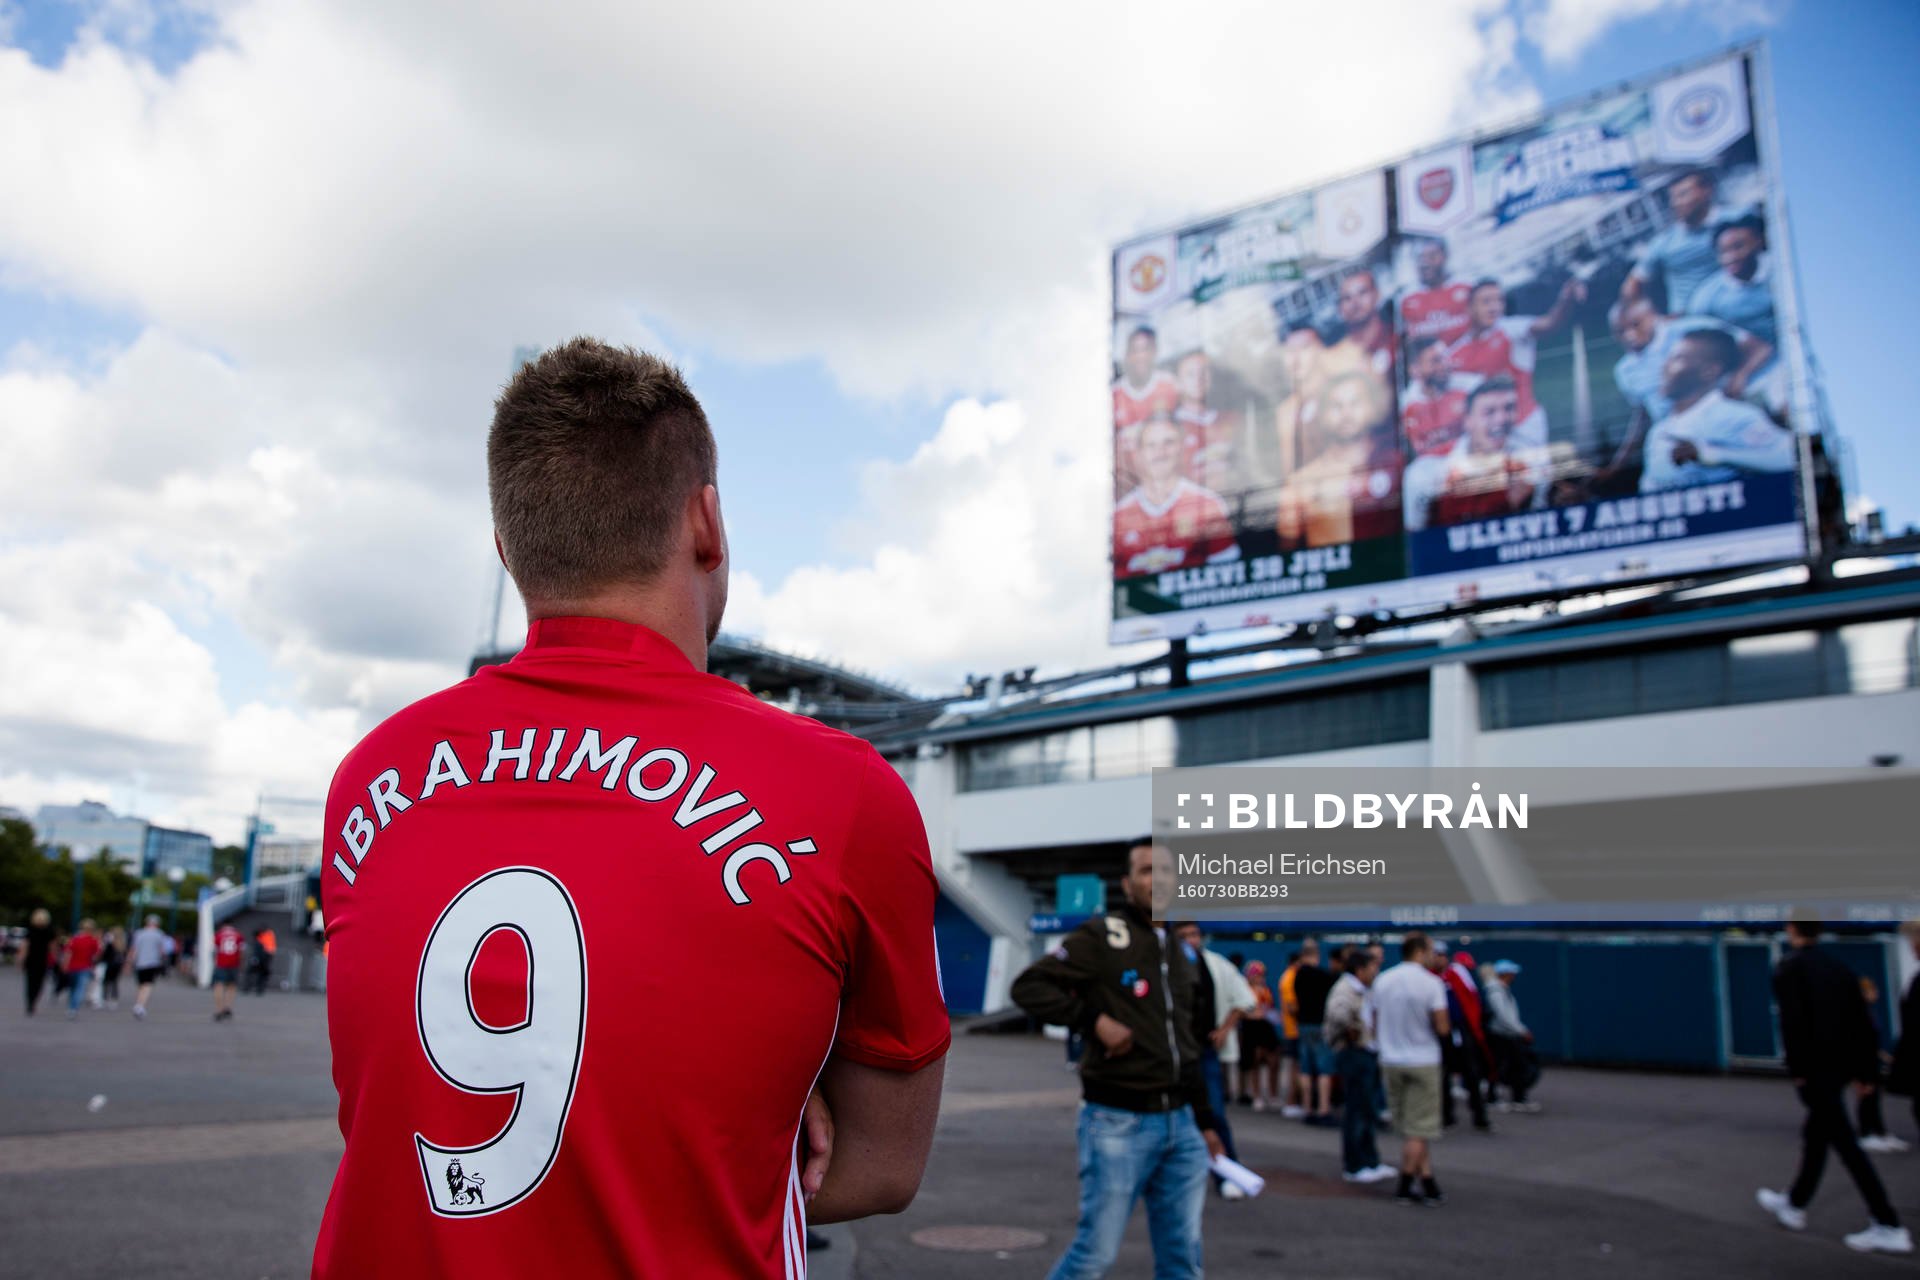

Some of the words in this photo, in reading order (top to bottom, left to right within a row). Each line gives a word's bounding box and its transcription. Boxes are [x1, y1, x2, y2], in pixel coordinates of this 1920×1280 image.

[1447, 509, 1558, 552] ULLEVI
[1564, 505, 1588, 532] 7
[1594, 480, 1746, 530] AUGUSTI
[1288, 543, 1351, 577] JULI
[332, 726, 817, 906] IBRAHIMOVIĆ
[1104, 916, 1131, 949] 5
[1390, 903, 1459, 926] ULLEVI
[413, 865, 588, 1219] 9
